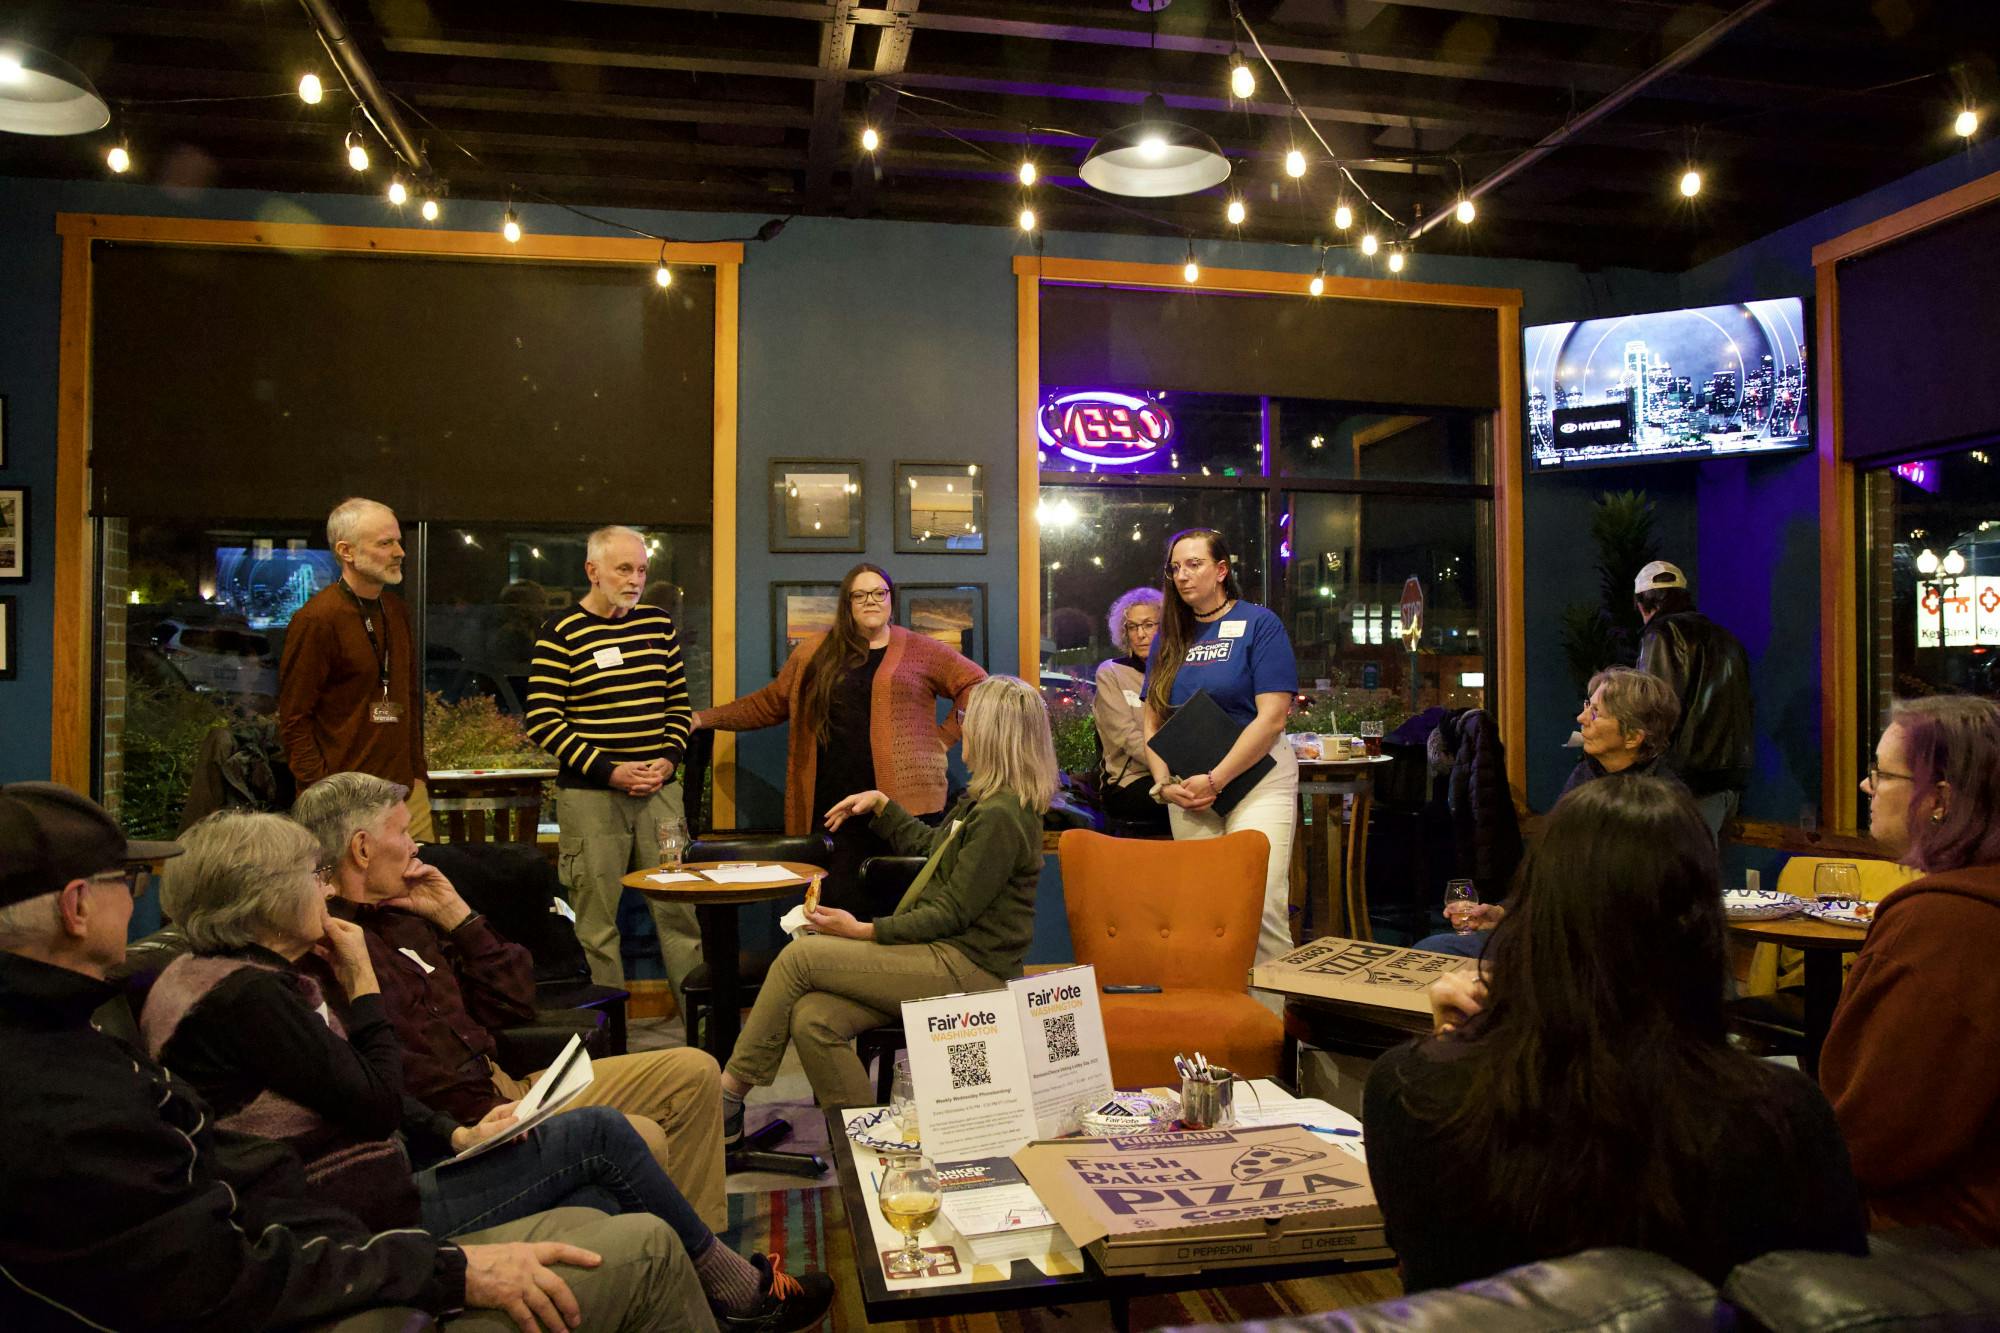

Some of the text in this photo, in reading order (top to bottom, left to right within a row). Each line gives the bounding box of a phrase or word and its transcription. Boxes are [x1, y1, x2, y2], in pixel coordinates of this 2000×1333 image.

[1185, 648, 1229, 662] OTING
[1287, 946, 1333, 964] COSTCO
[1303, 943, 1396, 976] PIZZA
[1031, 999, 1083, 1017] WASHINGTON
[931, 1025, 998, 1042] WASHINGTON
[1116, 1131, 1228, 1146] KIRKLAND
[936, 1166, 991, 1176] ANKED-
[937, 1171, 985, 1181] HOICE
[1094, 1173, 1365, 1215] PIZZA
[1180, 1198, 1338, 1220] COSTCO
[1317, 1236, 1357, 1248] CHEESE
[1193, 1244, 1253, 1257] PEPPERONI
